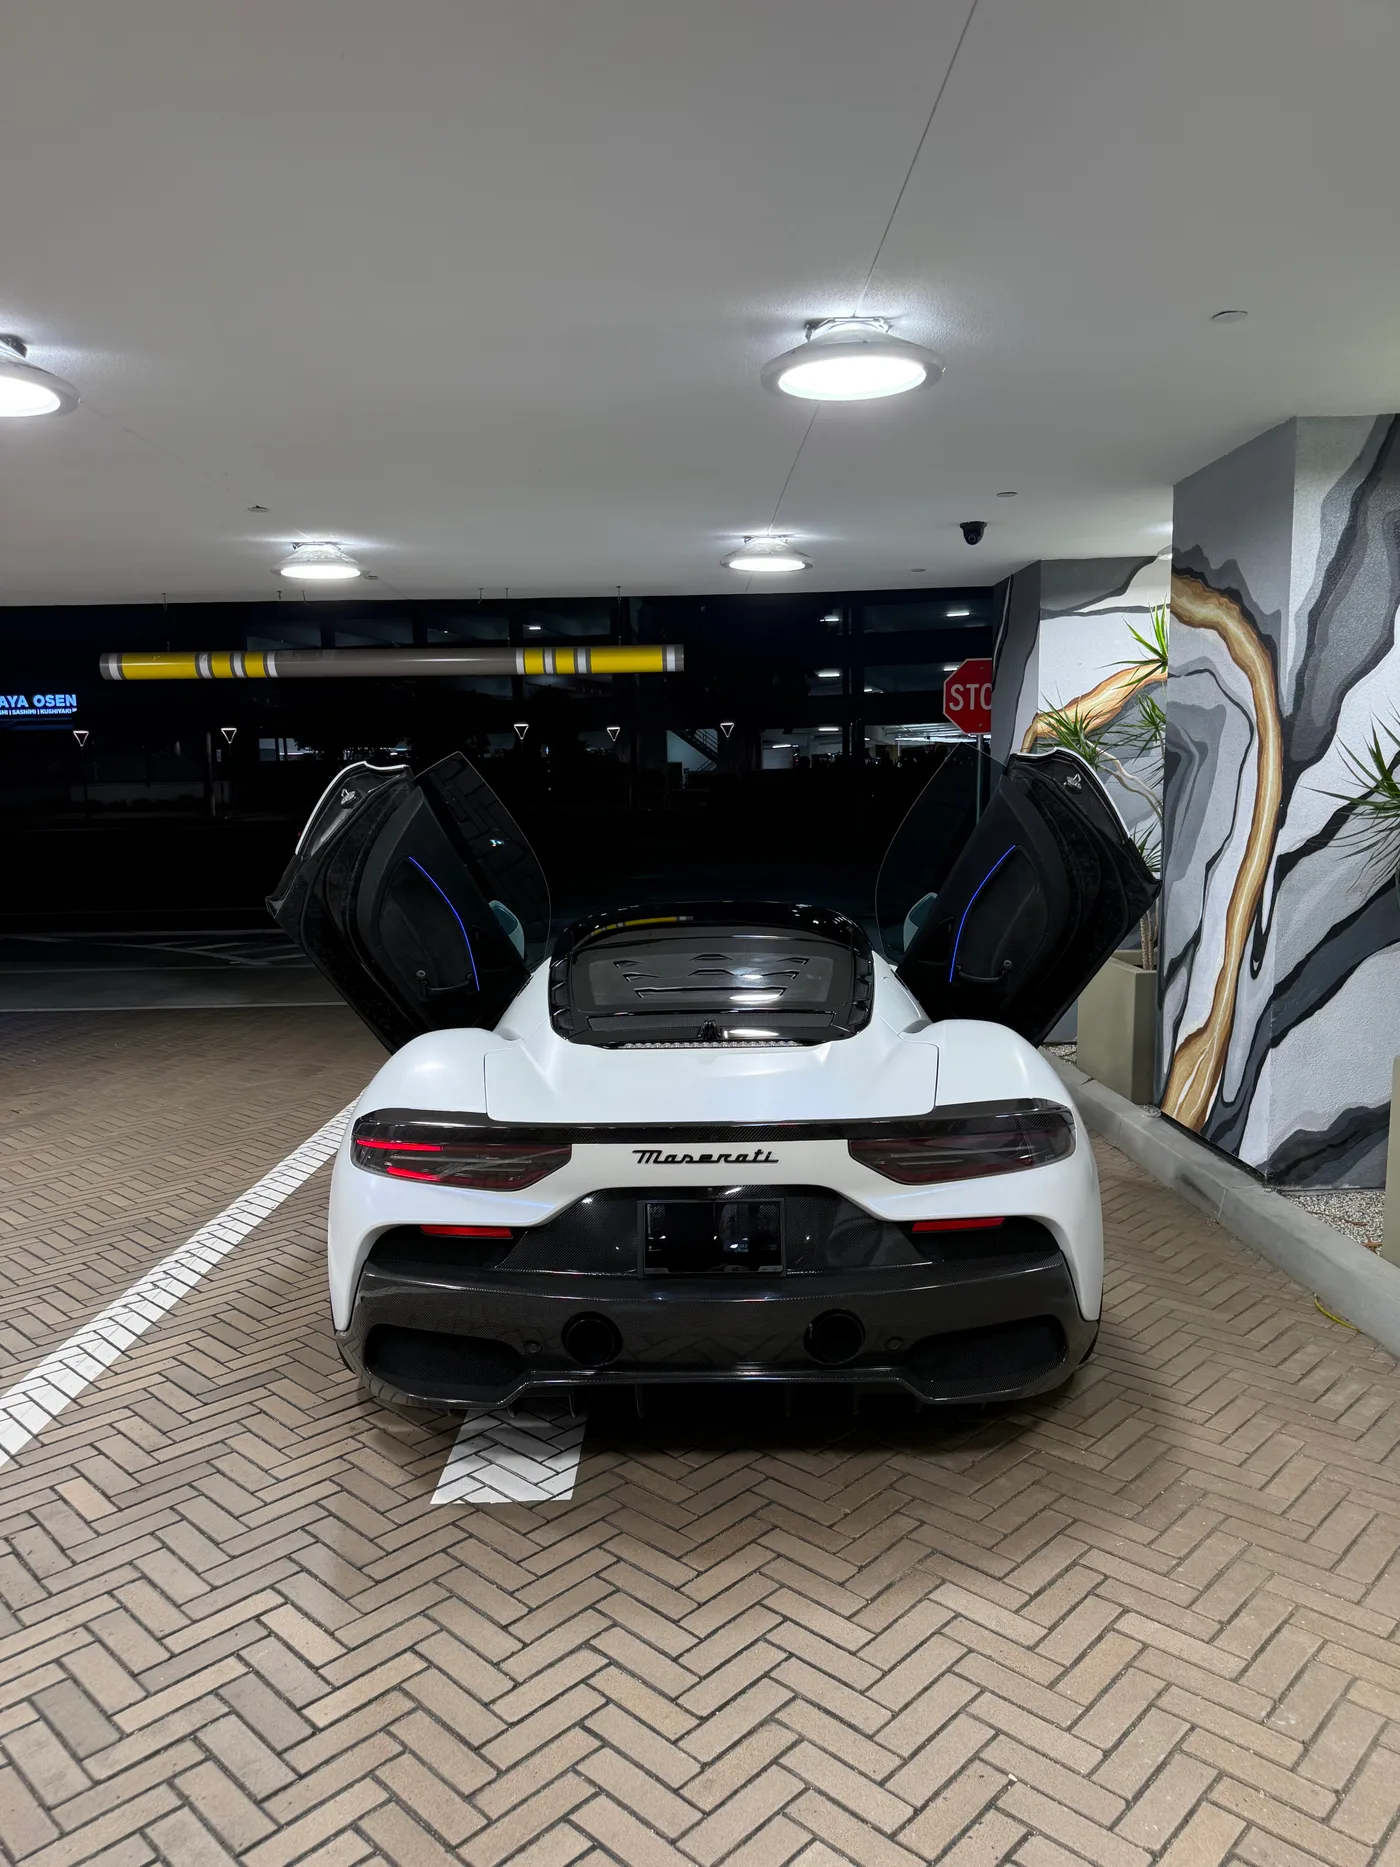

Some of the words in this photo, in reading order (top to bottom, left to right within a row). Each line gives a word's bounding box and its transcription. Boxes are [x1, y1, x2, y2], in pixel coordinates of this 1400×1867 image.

[0, 695, 29, 708] AYA
[33, 694, 77, 707] OSEN
[632, 1148, 779, 1164] Maserati
